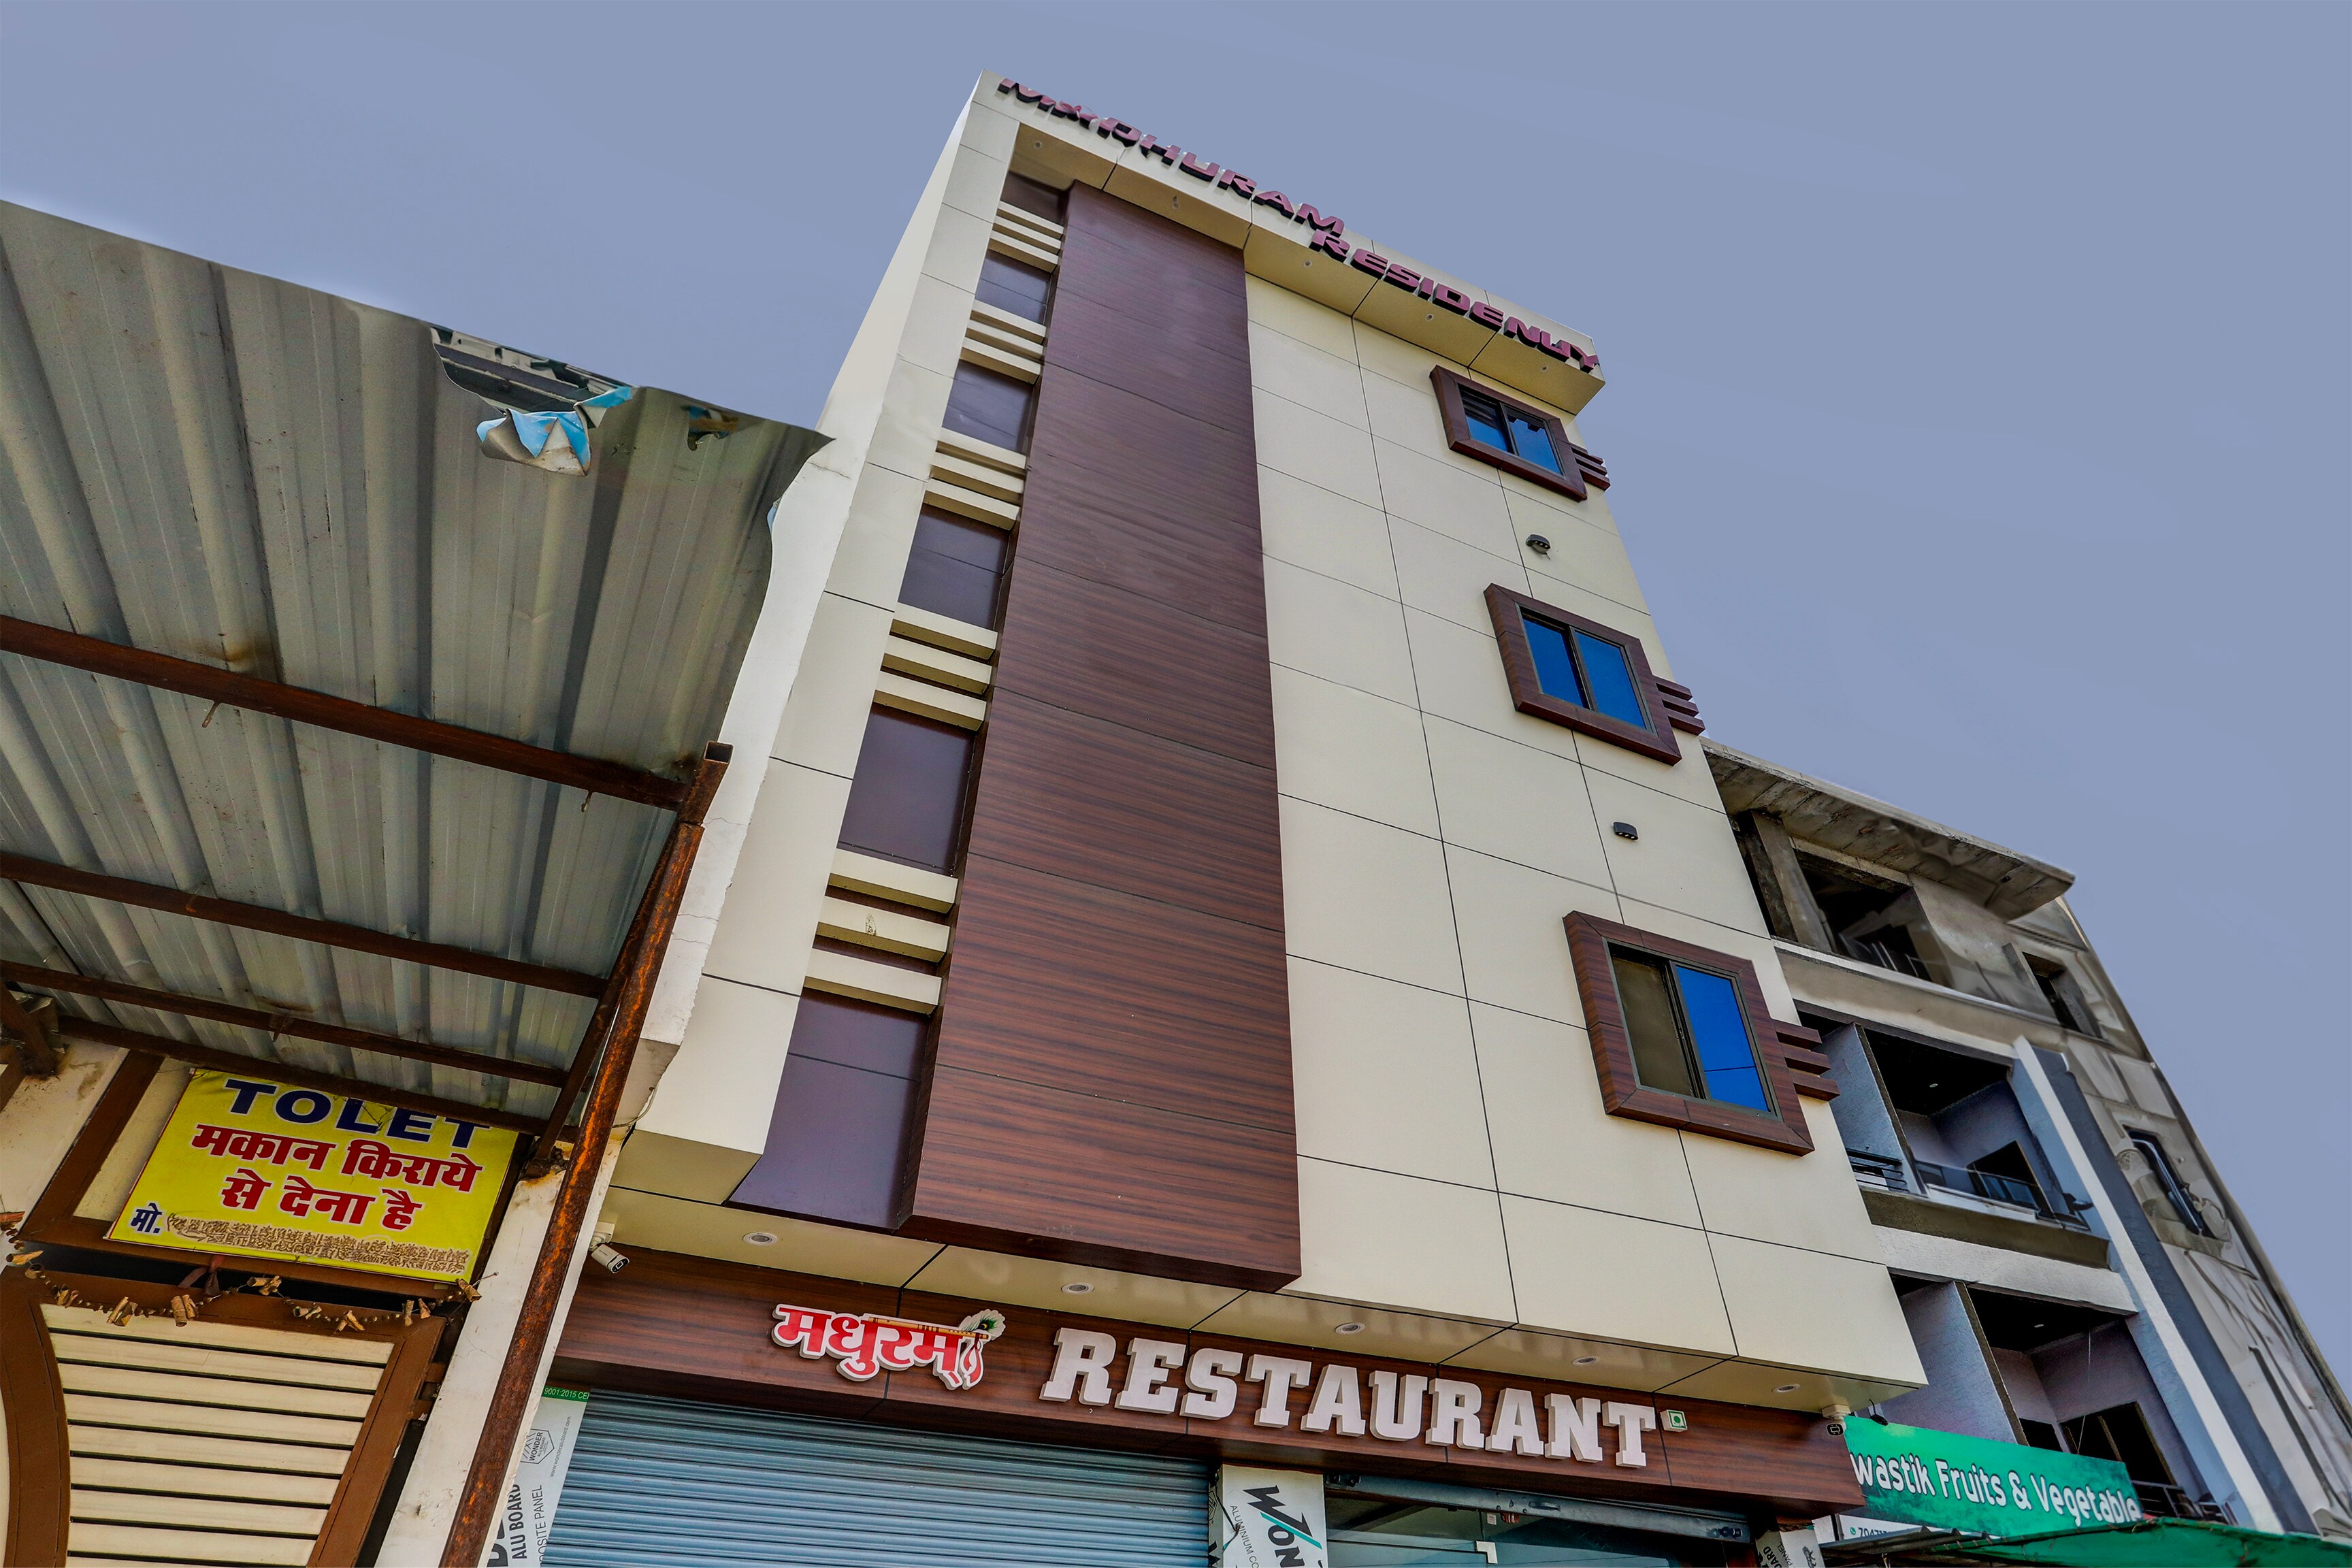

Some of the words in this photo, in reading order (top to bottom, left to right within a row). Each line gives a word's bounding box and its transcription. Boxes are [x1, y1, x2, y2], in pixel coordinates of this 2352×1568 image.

[191, 1124, 336, 1170] मकान
[342, 1139, 483, 1191] किराये
[222, 1169, 272, 1210] से
[280, 1175, 376, 1224] देना
[382, 1188, 422, 1230] है
[544, 1388, 576, 1399] 9001:2015
[1039, 1328, 1656, 1467] RESTAURANT
[529, 1432, 543, 1461] WONDER
[532, 1484, 544, 1519] PANEL
[1936, 1459, 2007, 1507] Fruits
[2008, 1471, 2032, 1510] &
[510, 1535, 527, 1559] ALU
